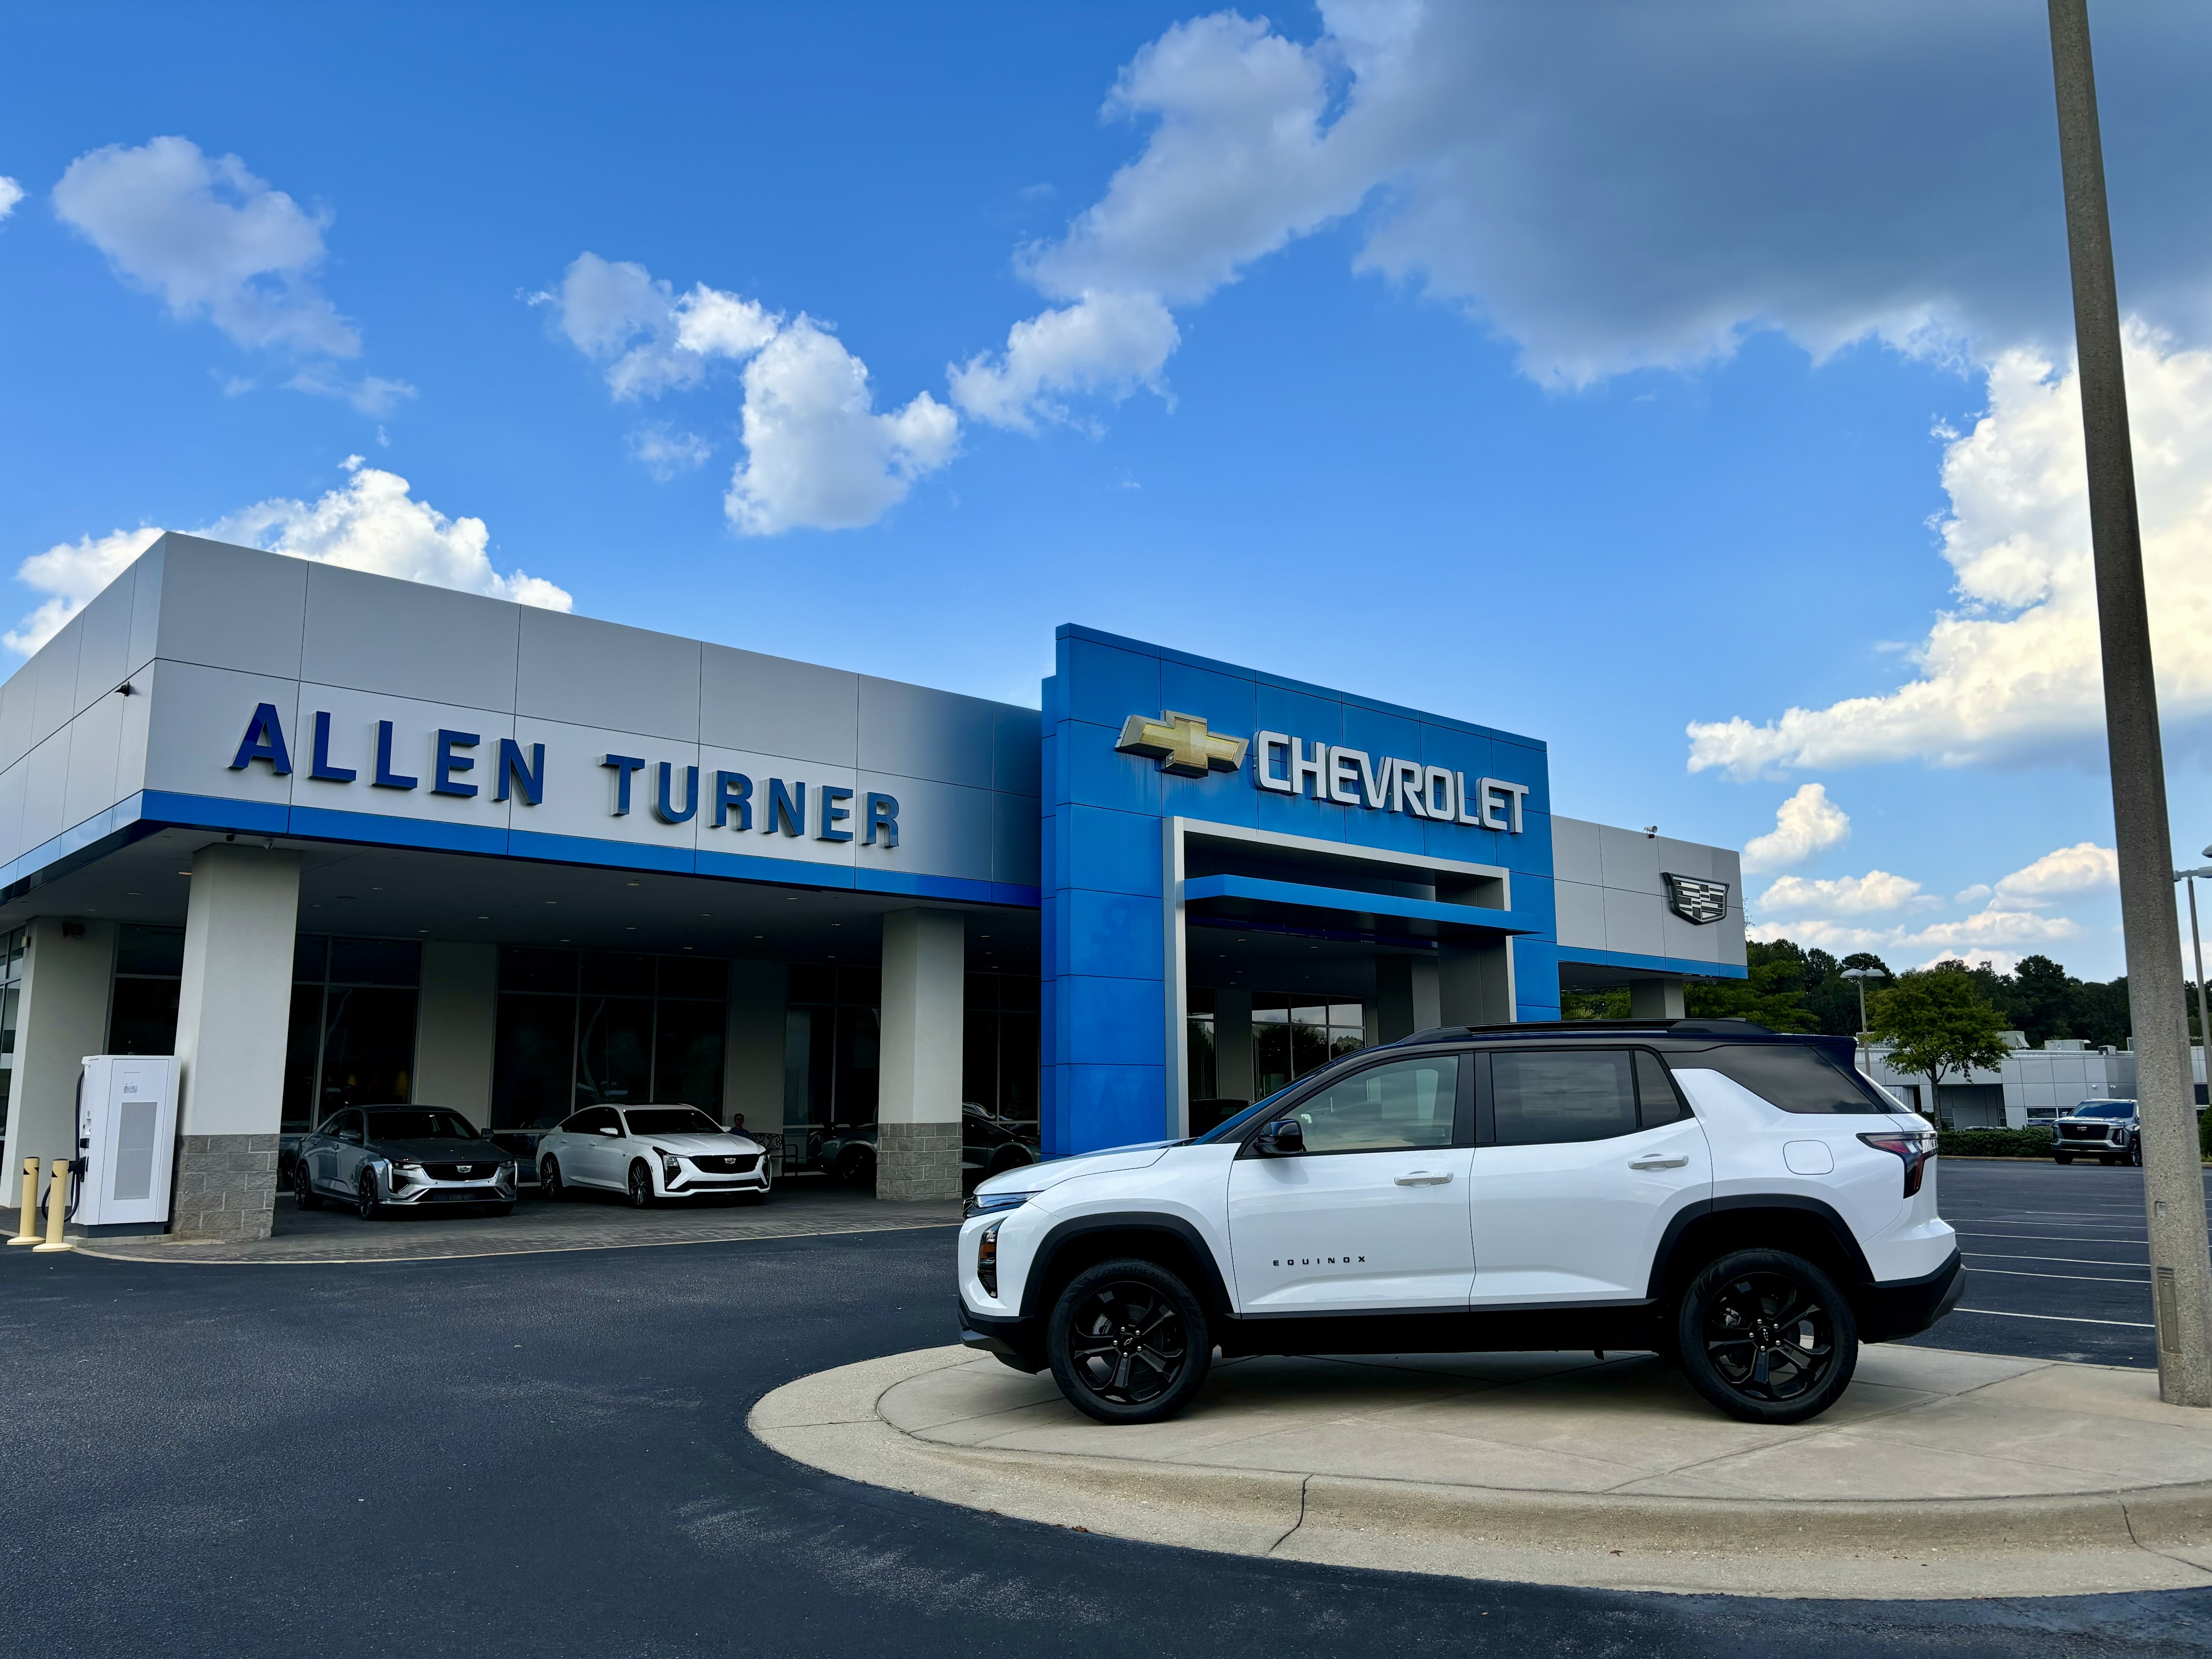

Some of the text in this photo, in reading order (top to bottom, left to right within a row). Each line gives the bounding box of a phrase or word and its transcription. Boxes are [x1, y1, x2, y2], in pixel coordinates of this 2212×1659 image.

[228, 702, 899, 848] ALLEN TURNER
[1253, 730, 1529, 835] CHEVROLET
[1273, 1256, 1365, 1266] EQUINOX
